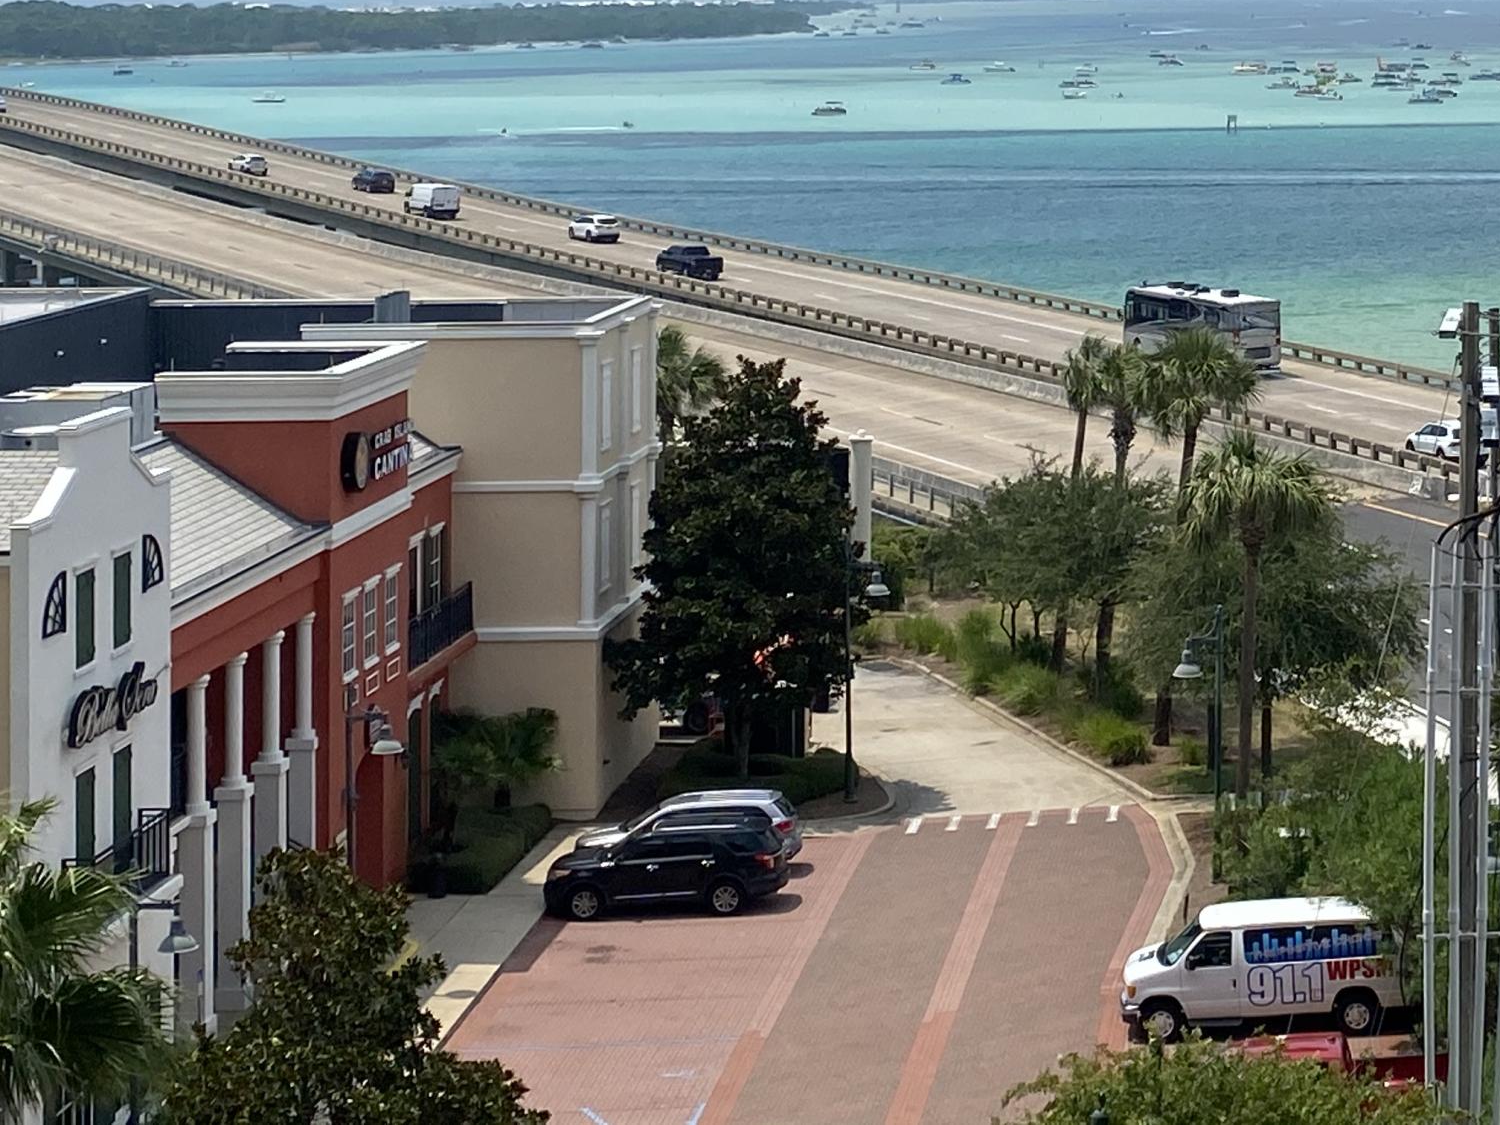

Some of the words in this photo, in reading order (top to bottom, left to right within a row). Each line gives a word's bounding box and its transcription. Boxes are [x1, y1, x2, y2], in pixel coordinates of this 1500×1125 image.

[374, 428, 392, 449] CRAB
[374, 441, 414, 480] CANTINA
[1247, 962, 1324, 1006] 91.1
